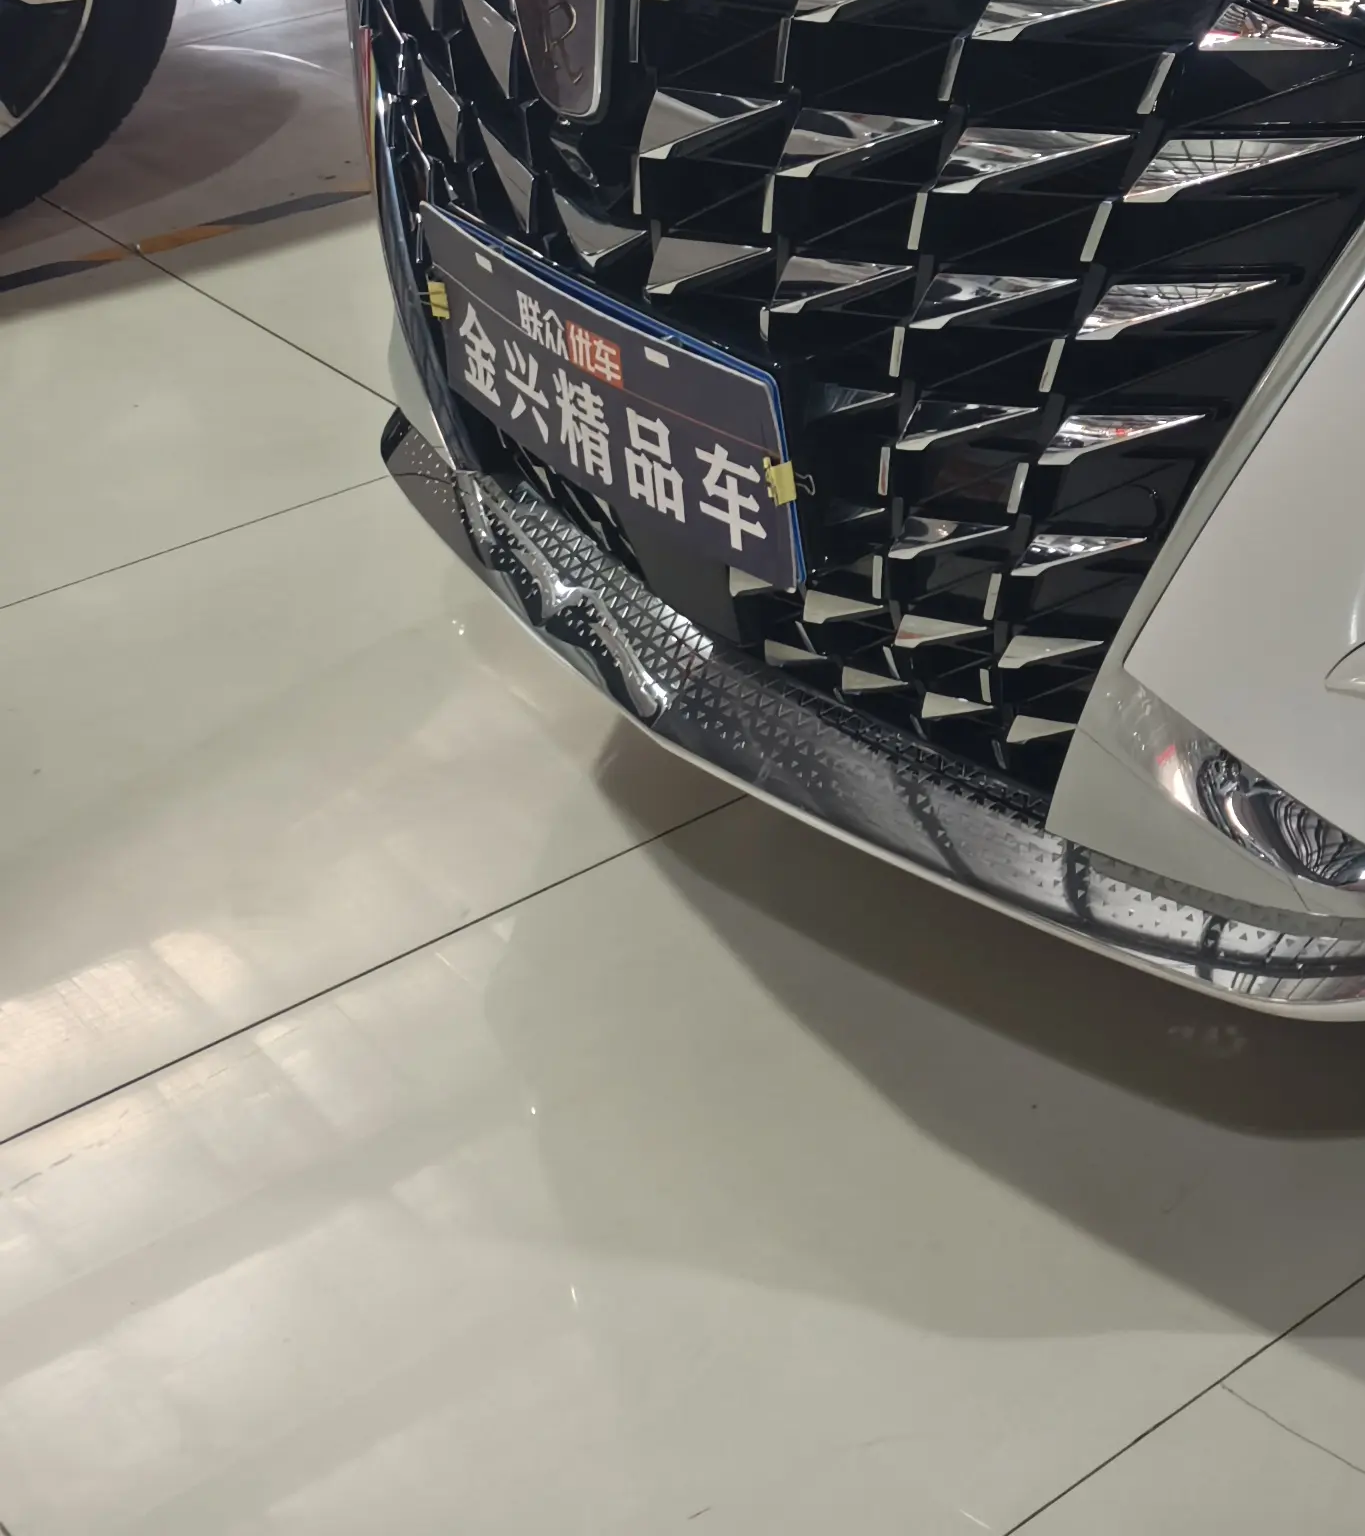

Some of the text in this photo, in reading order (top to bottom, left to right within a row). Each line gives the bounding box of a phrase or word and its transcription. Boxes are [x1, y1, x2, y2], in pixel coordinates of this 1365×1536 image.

[516, 289, 622, 384] 联众优车
[459, 302, 767, 552] 金兴精品车
